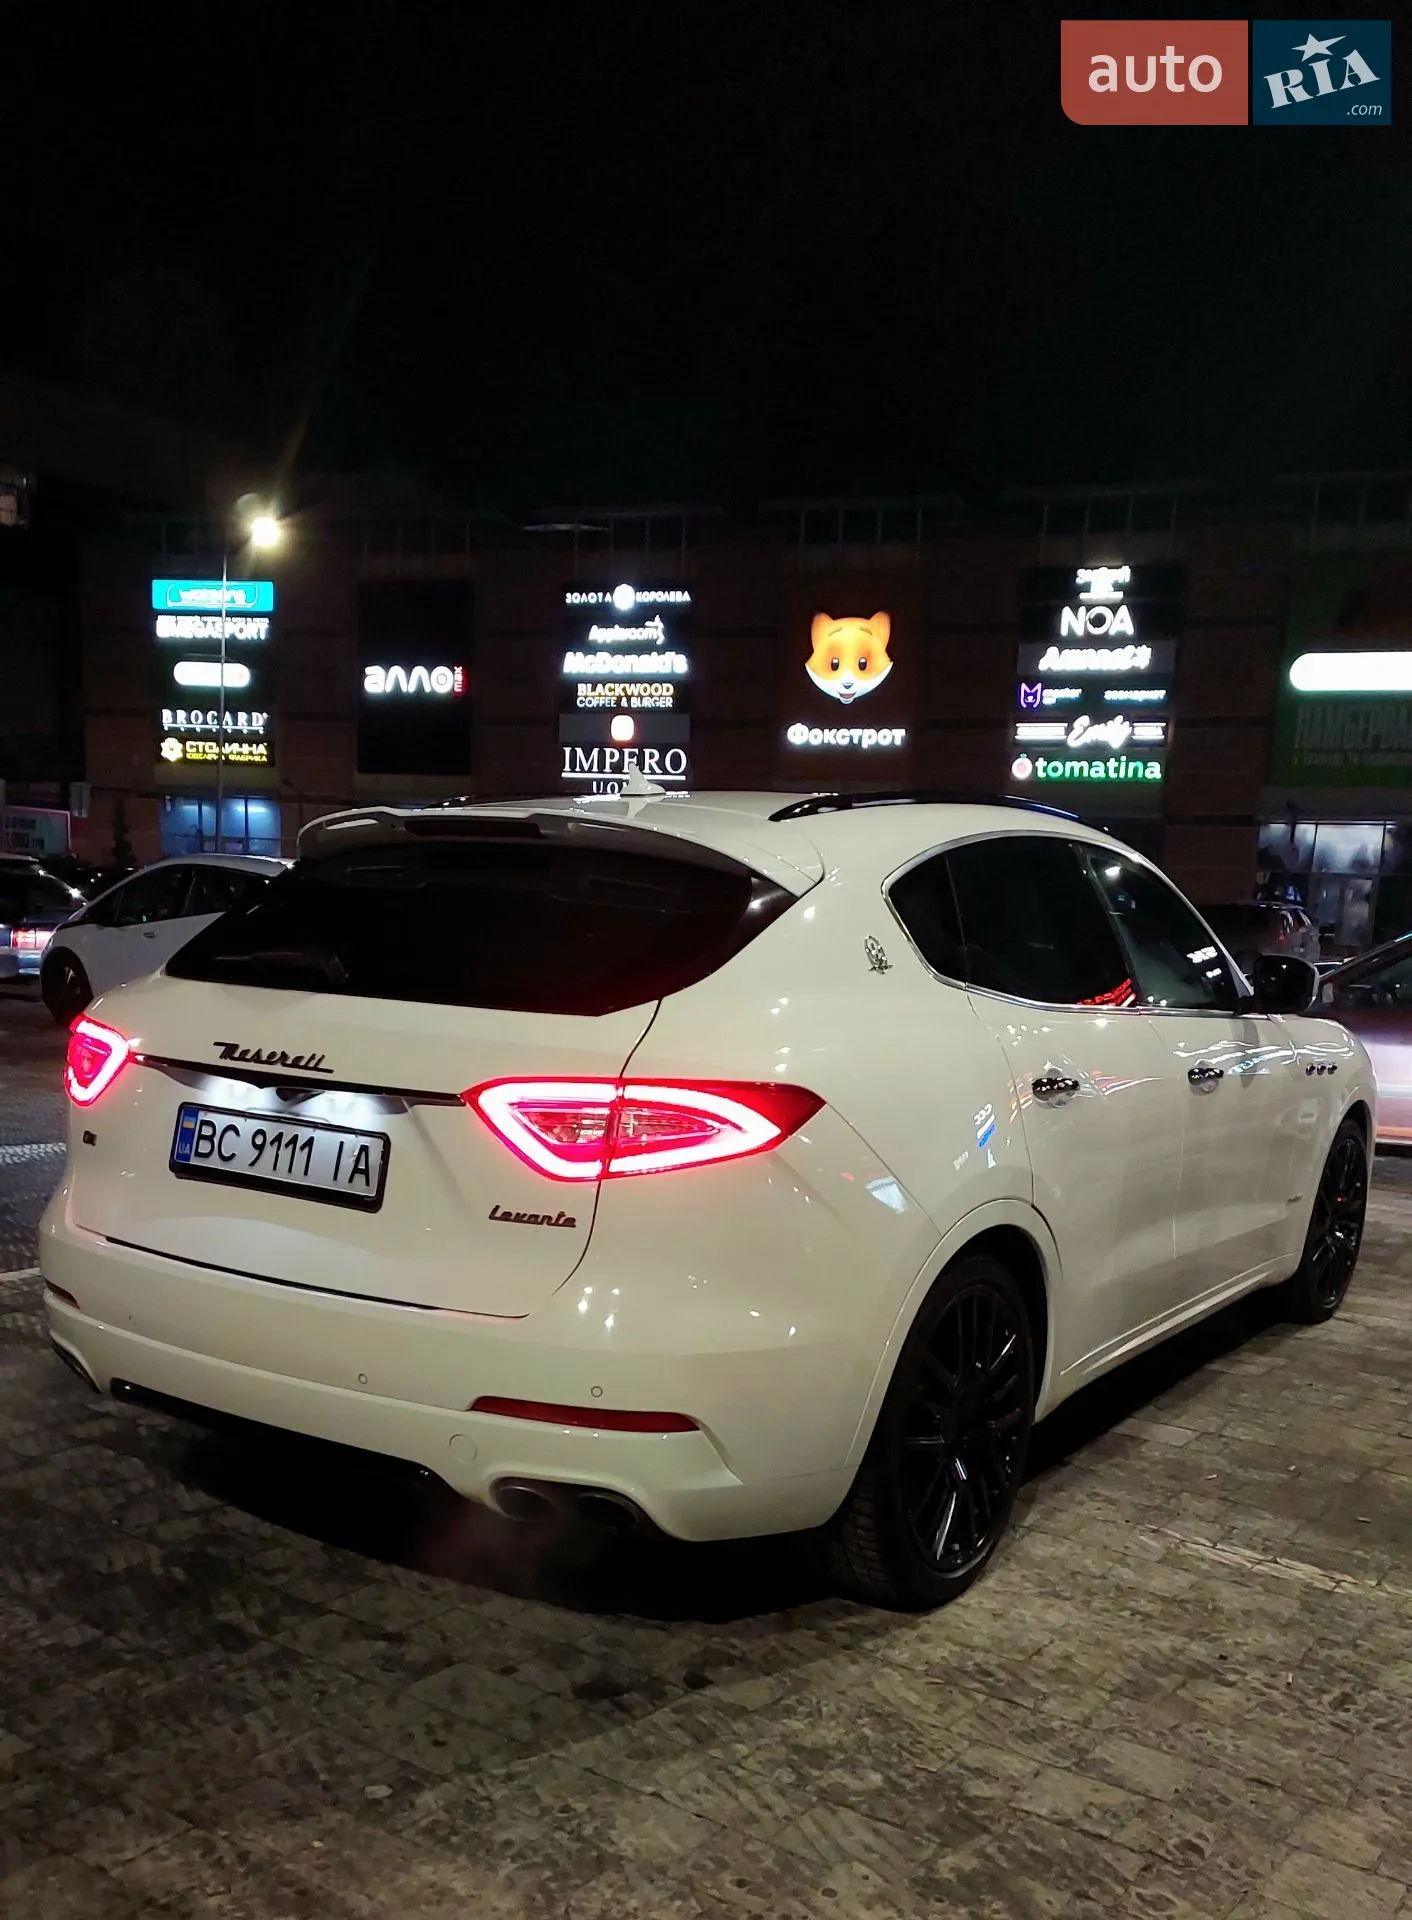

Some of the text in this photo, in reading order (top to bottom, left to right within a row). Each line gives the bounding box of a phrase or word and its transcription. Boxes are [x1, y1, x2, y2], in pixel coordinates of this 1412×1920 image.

[566, 591, 691, 603] ЗОЛОТА КОРОЛЕВА
[1061, 604, 1134, 636] NOA
[563, 652, 687, 673] McDonald's
[577, 683, 674, 696] BLACKWOOD
[576, 697, 673, 708] COFFEE & BURGER
[787, 723, 906, 749] Фокстрот
[1035, 756, 1162, 779] tomatina
[179, 1144, 190, 1155] UA
[194, 1120, 370, 1186] BC 9111 IA
[489, 1205, 577, 1228] Levante
